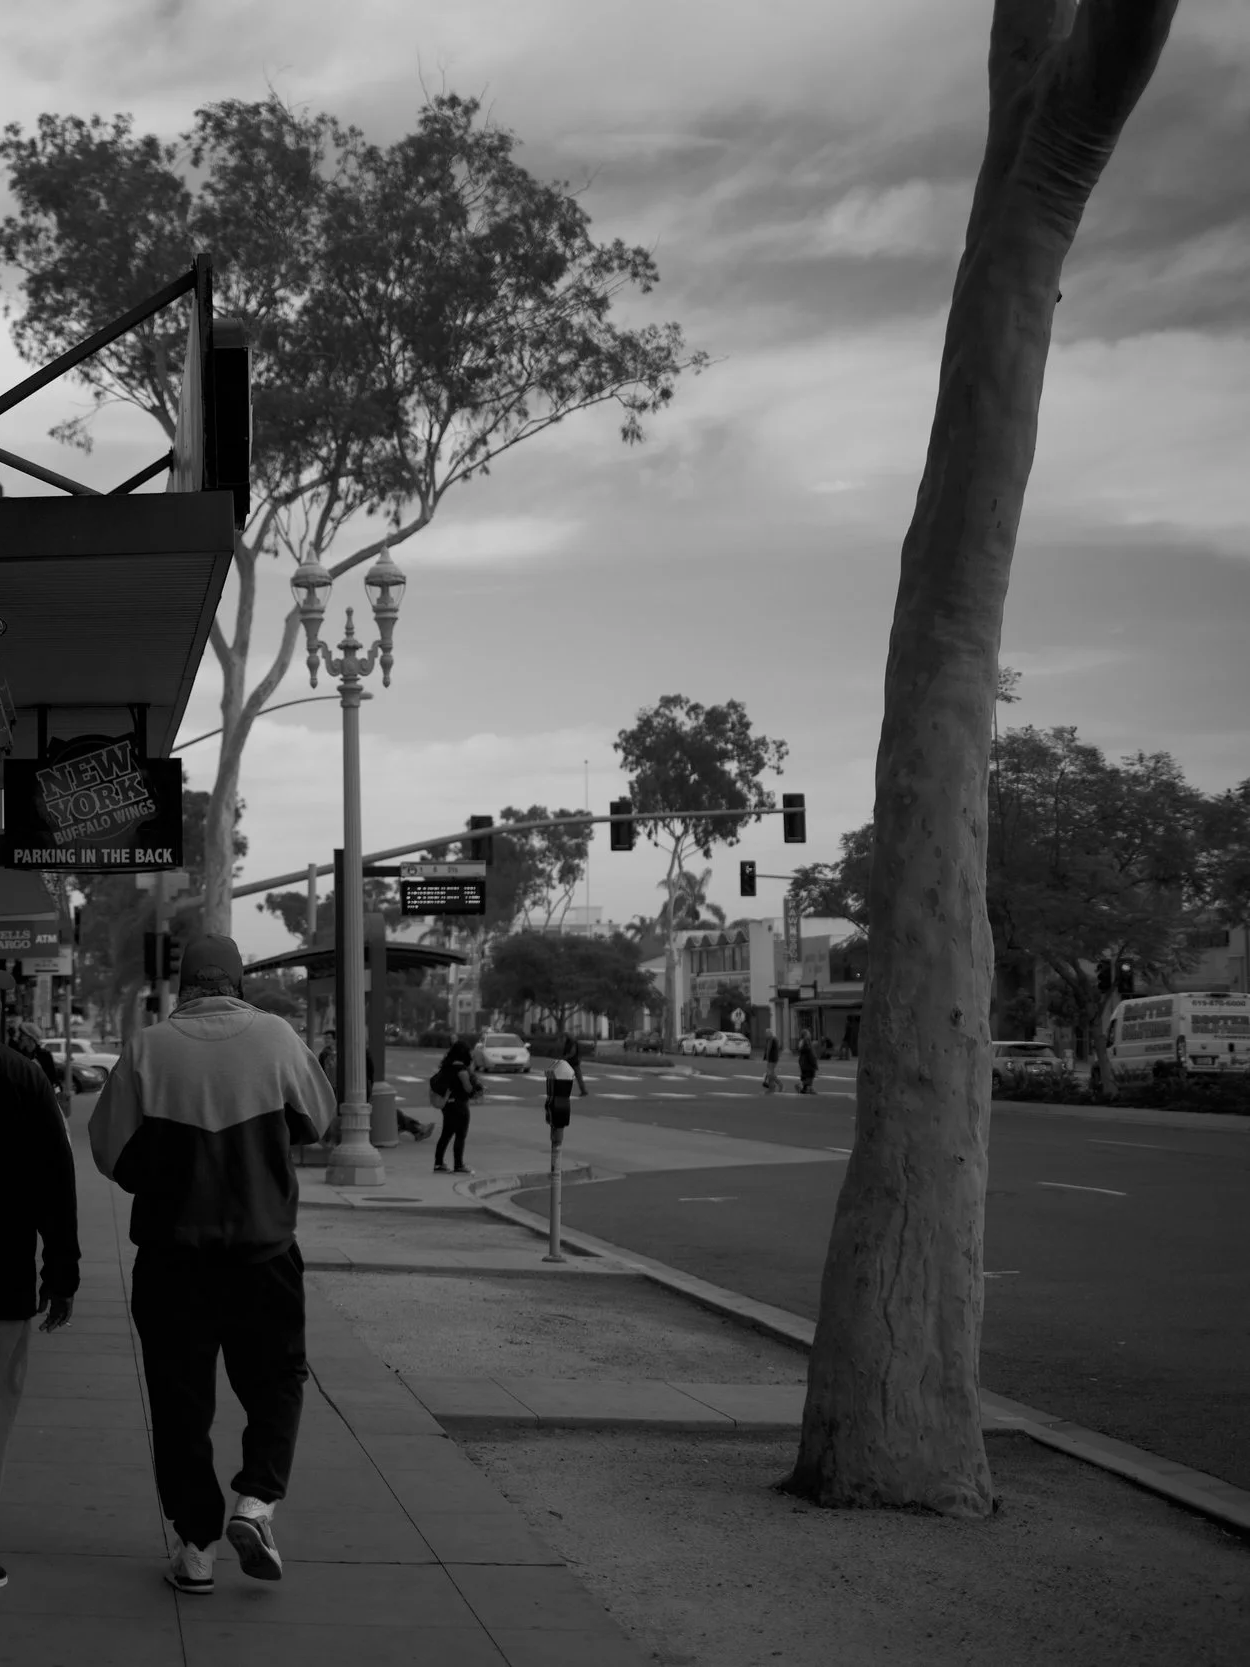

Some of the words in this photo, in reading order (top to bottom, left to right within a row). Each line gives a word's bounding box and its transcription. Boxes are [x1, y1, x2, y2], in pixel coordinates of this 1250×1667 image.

[35, 740, 133, 801] NEW
[46, 772, 149, 828] YORK
[53, 815, 111, 846] BUFFALO
[113, 799, 156, 824] WINGS
[13, 848, 76, 864] PARKING
[81, 848, 96, 864] IN
[101, 848, 130, 864] THE
[135, 848, 173, 864] BACK
[35, 934, 58, 944] ATM
